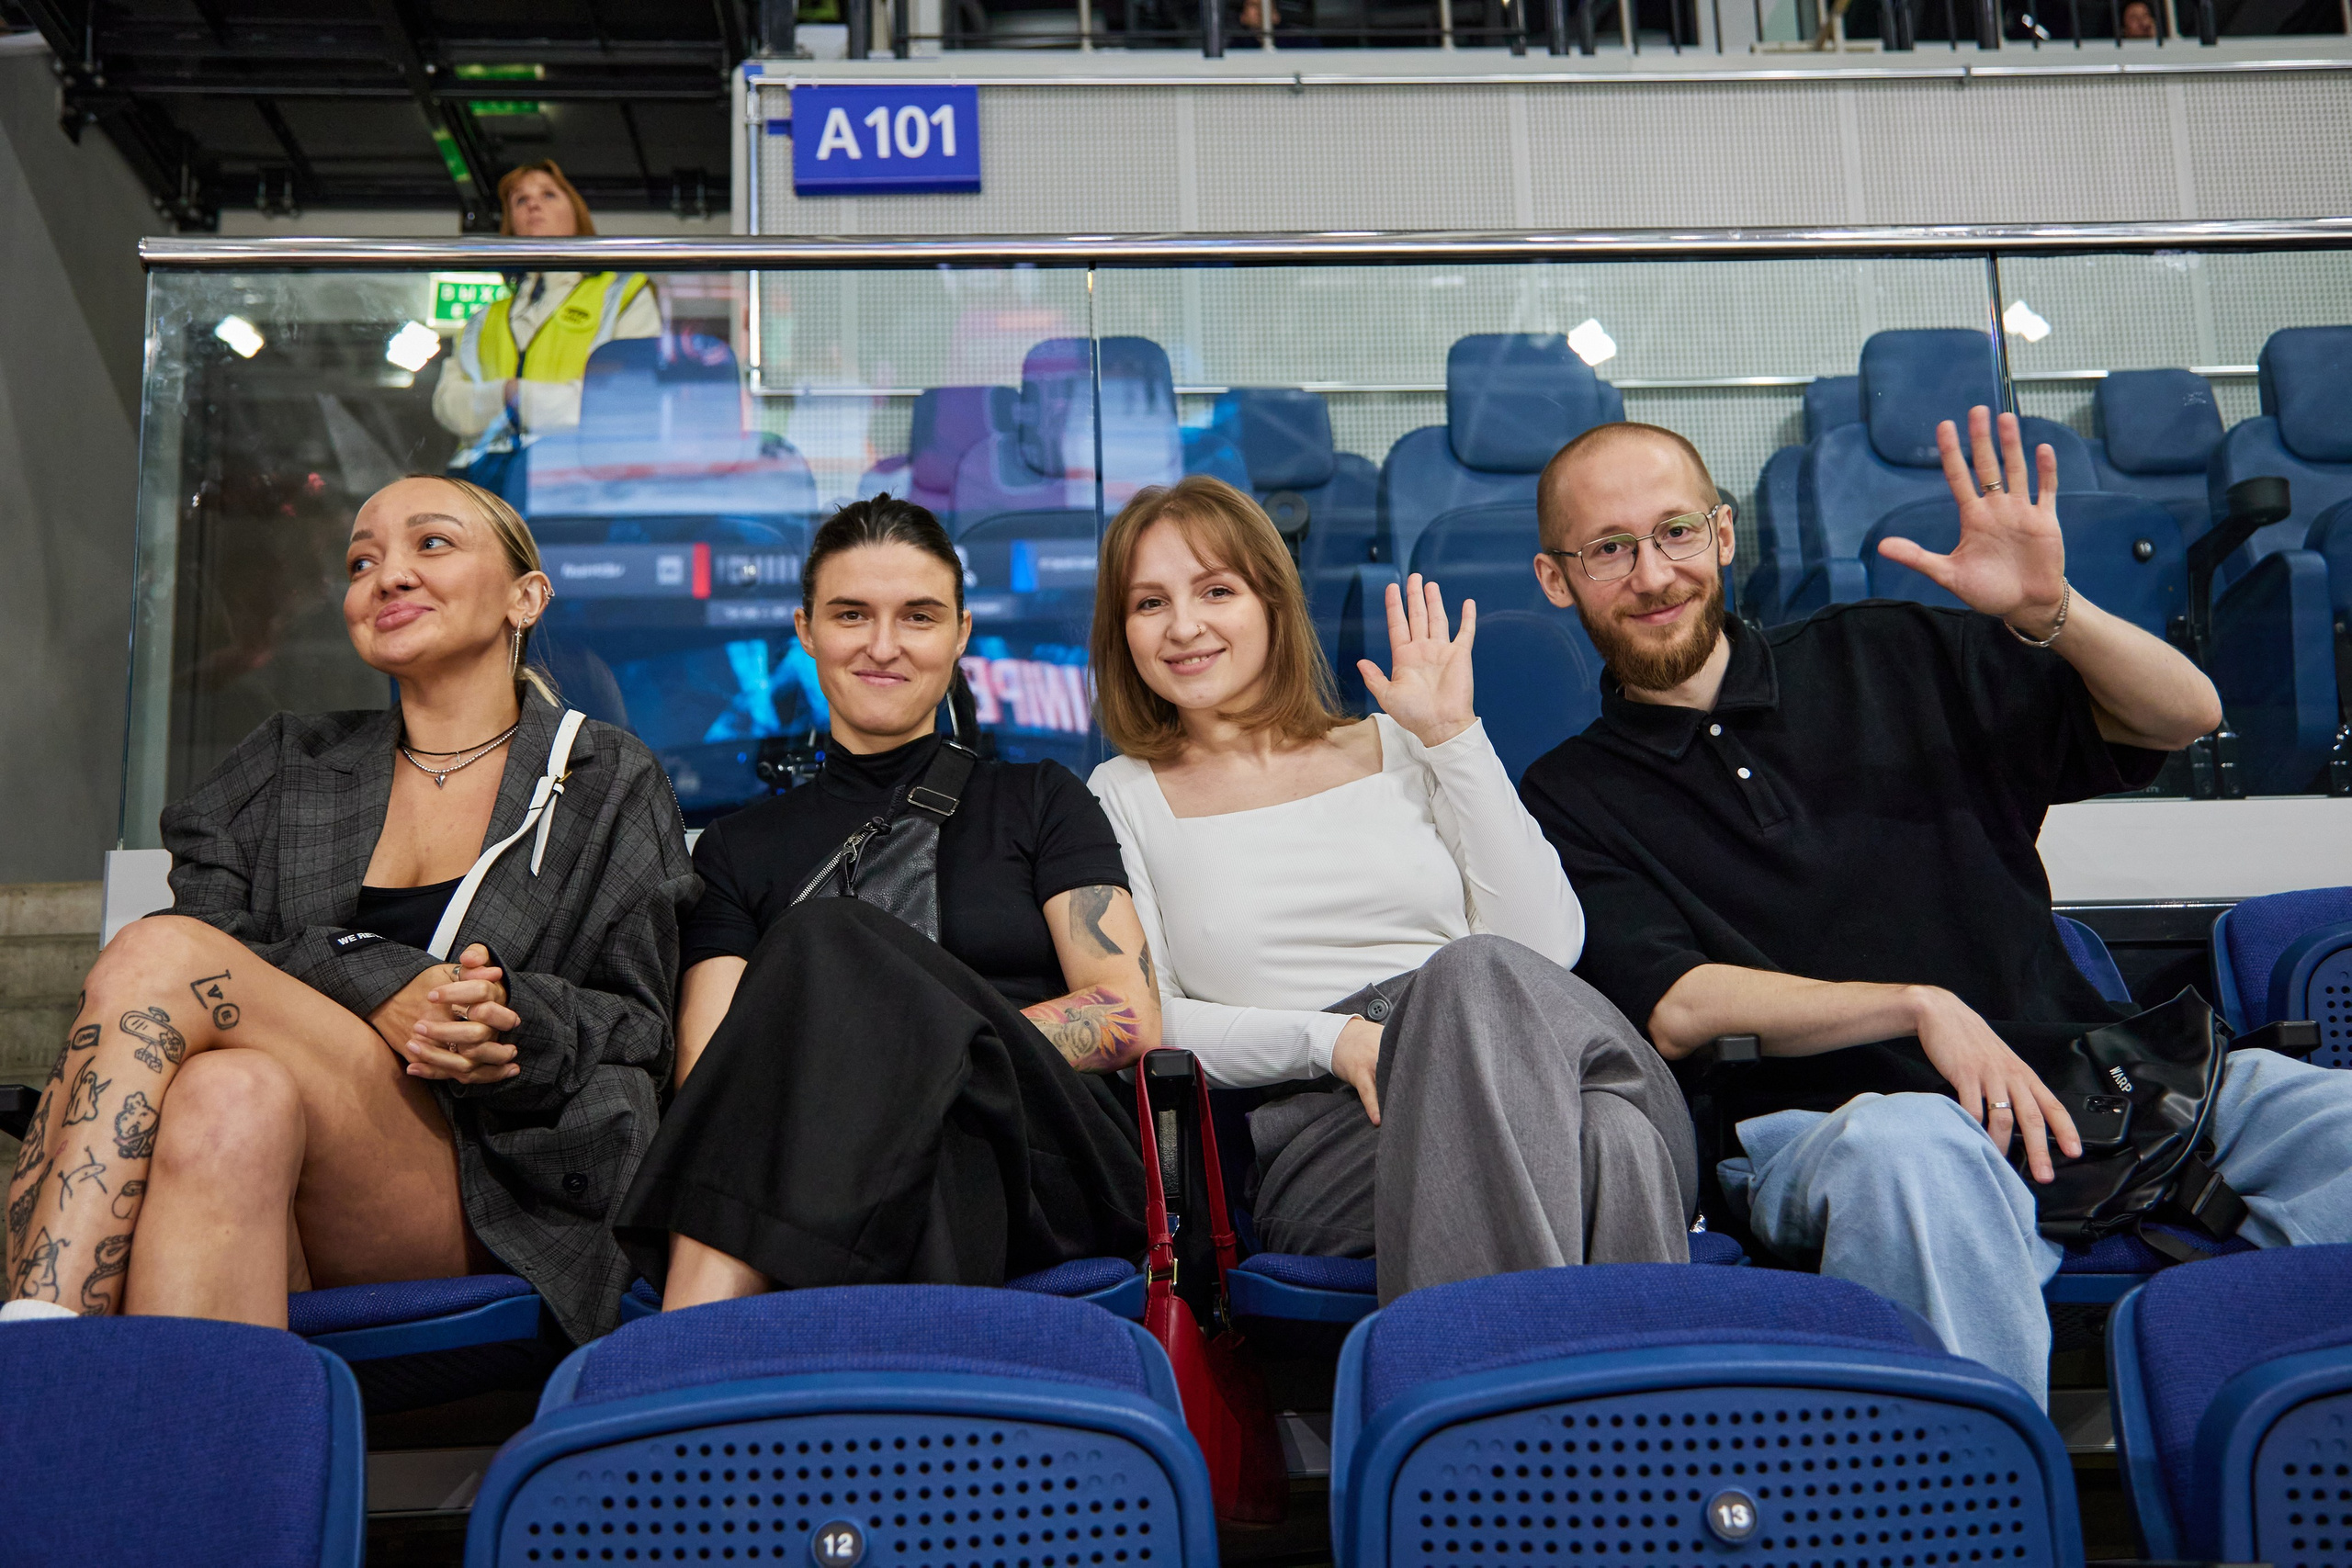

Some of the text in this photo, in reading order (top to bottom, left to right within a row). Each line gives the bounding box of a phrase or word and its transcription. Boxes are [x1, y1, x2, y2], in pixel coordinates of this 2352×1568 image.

[816, 104, 956, 161] A 101
[337, 934, 357, 946] WE
[2109, 1066, 2132, 1092] WARP
[1717, 1503, 1750, 1529] 13
[823, 1532, 854, 1558] 12
